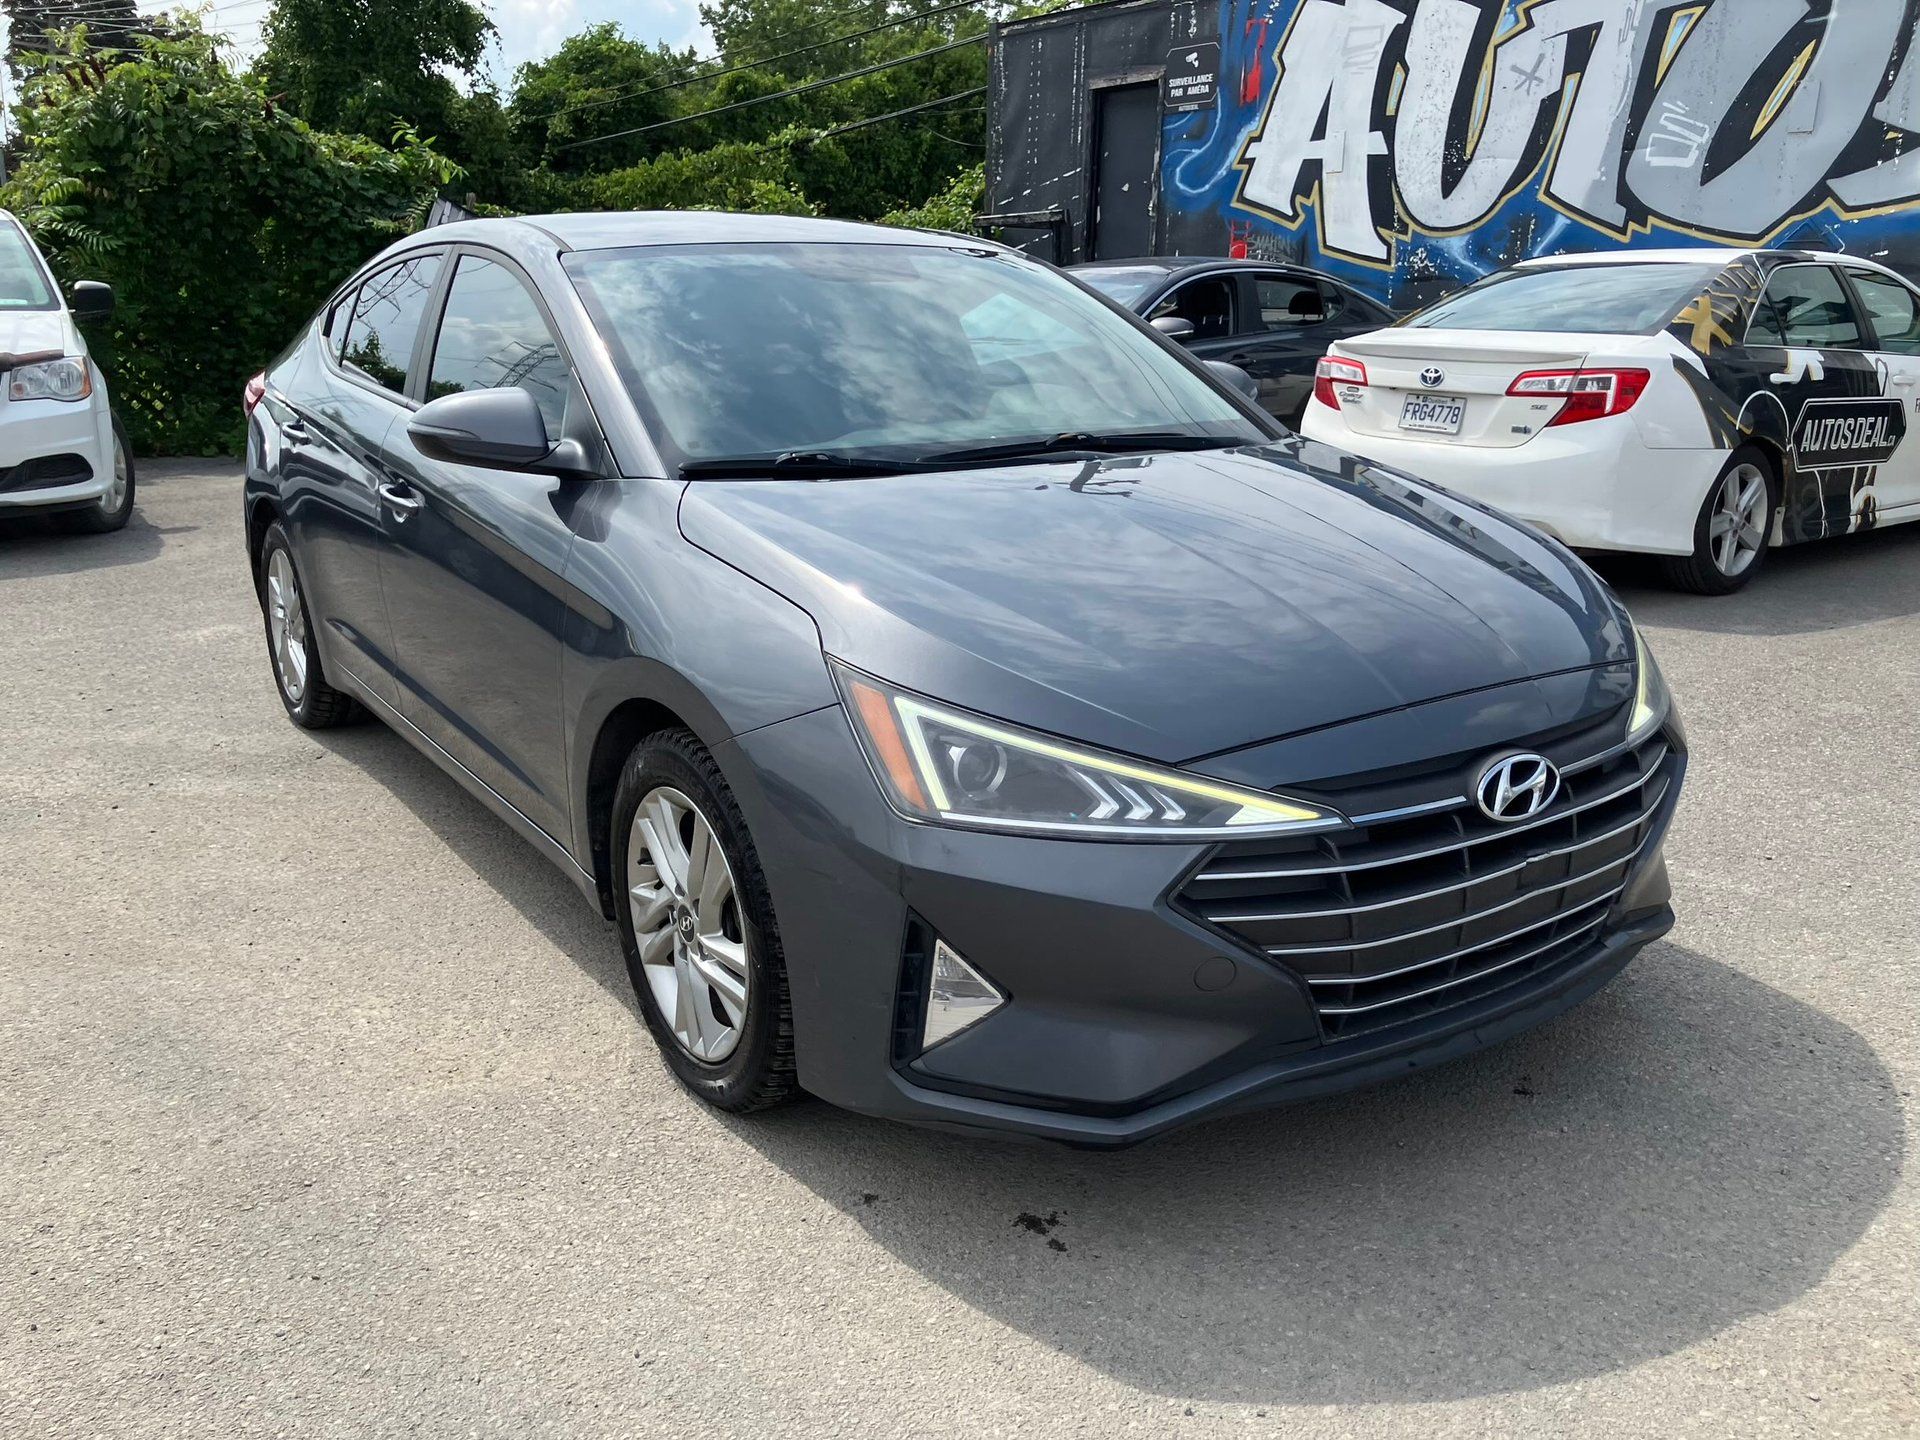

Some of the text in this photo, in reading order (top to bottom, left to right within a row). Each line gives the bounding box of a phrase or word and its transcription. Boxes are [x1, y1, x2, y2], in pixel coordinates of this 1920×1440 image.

[1169, 74, 1213, 87] SURVEILLANCE
[1170, 88, 1183, 98] PAR
[1403, 402, 1461, 424] FRG4778
